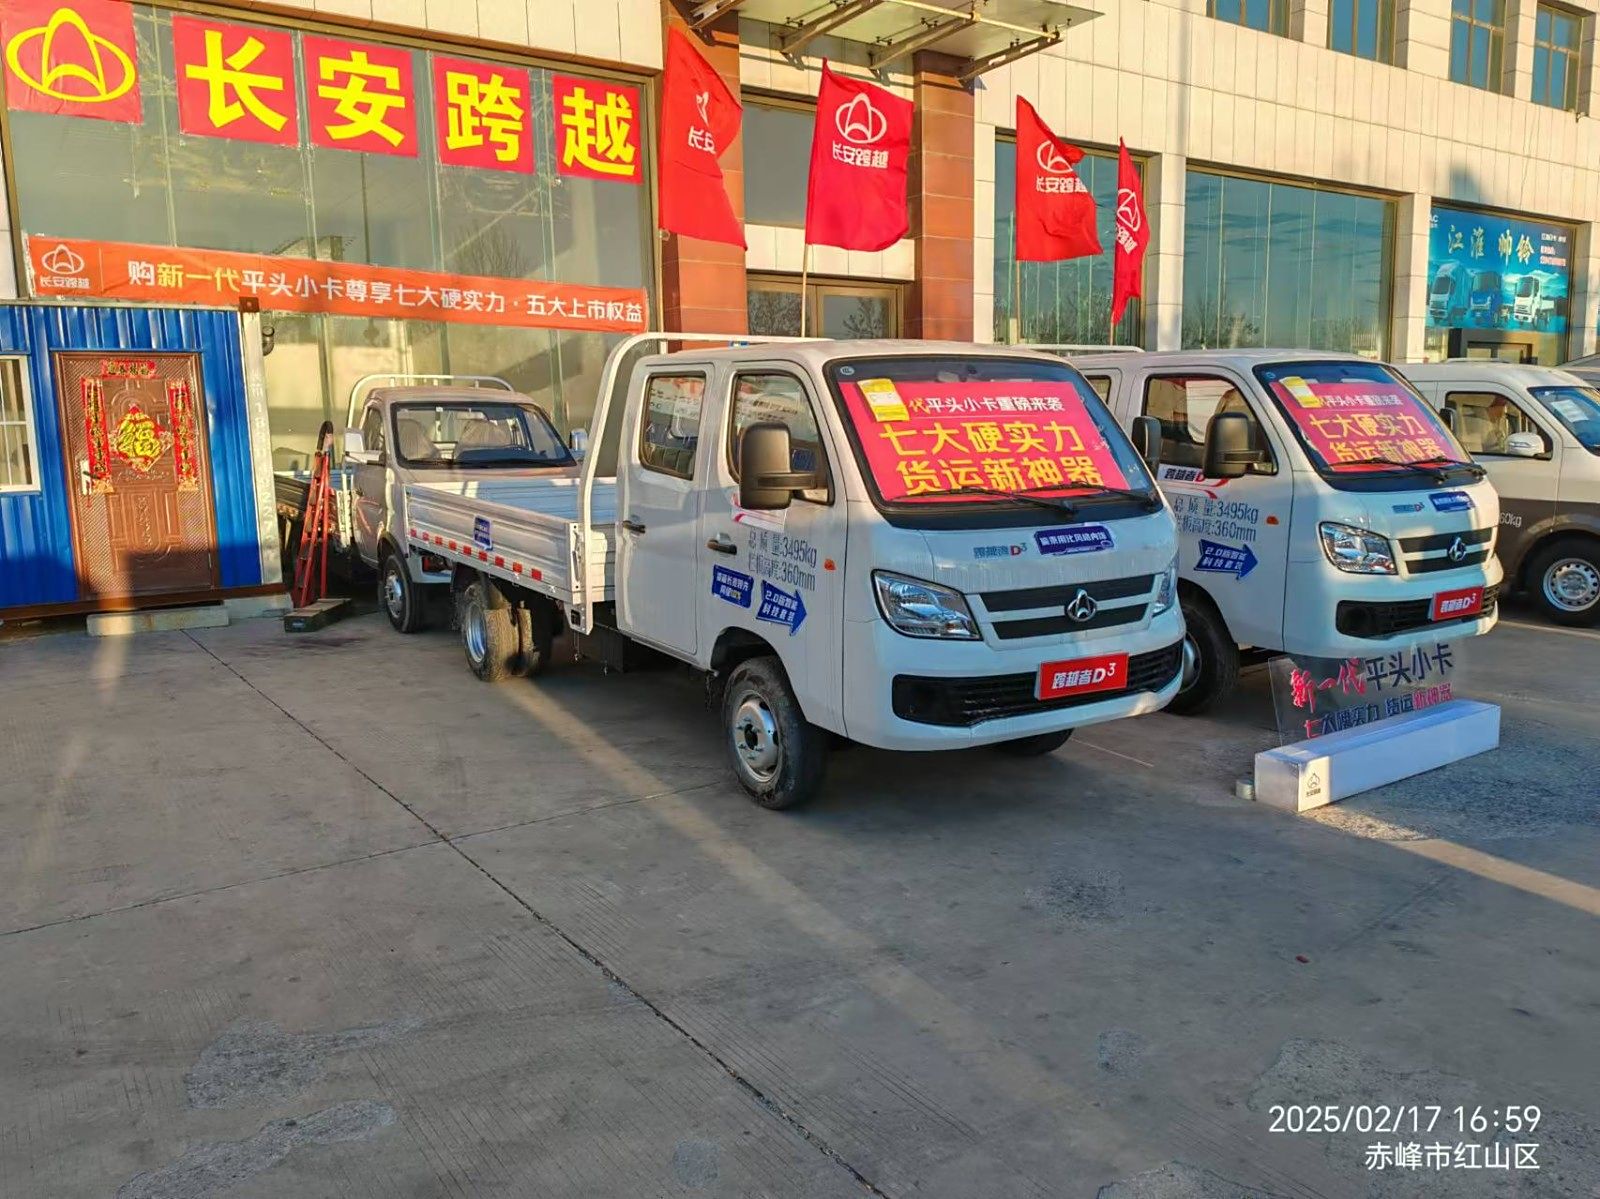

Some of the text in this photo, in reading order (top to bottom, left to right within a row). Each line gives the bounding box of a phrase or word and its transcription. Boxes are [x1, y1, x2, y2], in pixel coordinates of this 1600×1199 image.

[185, 30, 635, 176] 长安跨越
[832, 140, 889, 168] 长安跨越
[879, 420, 1085, 457] 七大硬实力
[1308, 412, 1427, 438] 七大硬实力
[895, 456, 1104, 496] 货运新神器
